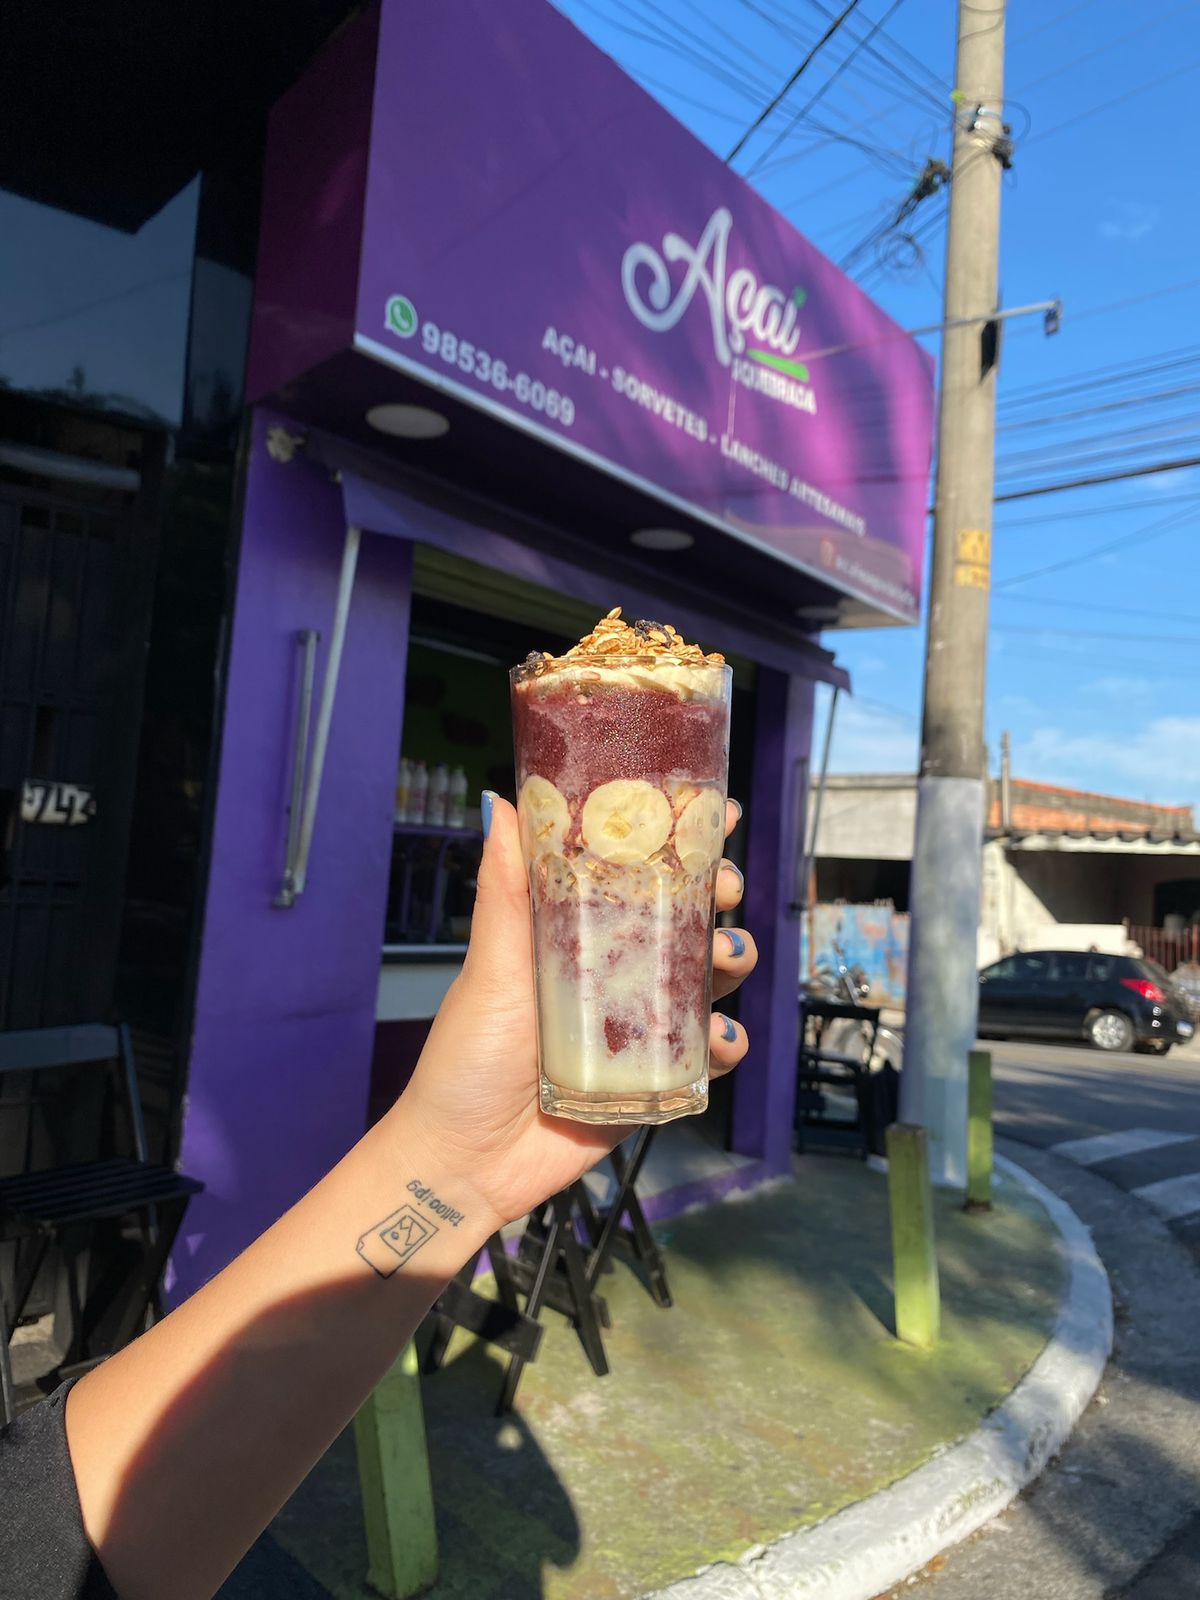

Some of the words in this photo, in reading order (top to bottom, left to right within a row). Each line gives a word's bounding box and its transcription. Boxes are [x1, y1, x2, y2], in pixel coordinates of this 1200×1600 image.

[421, 321, 576, 427] 98536-6069
[542, 325, 597, 376] AÇAI
[612, 365, 708, 442] SORVETES
[720, 432, 790, 492] LANCHES
[406, 1179, 465, 1227] tattoo.jpg
